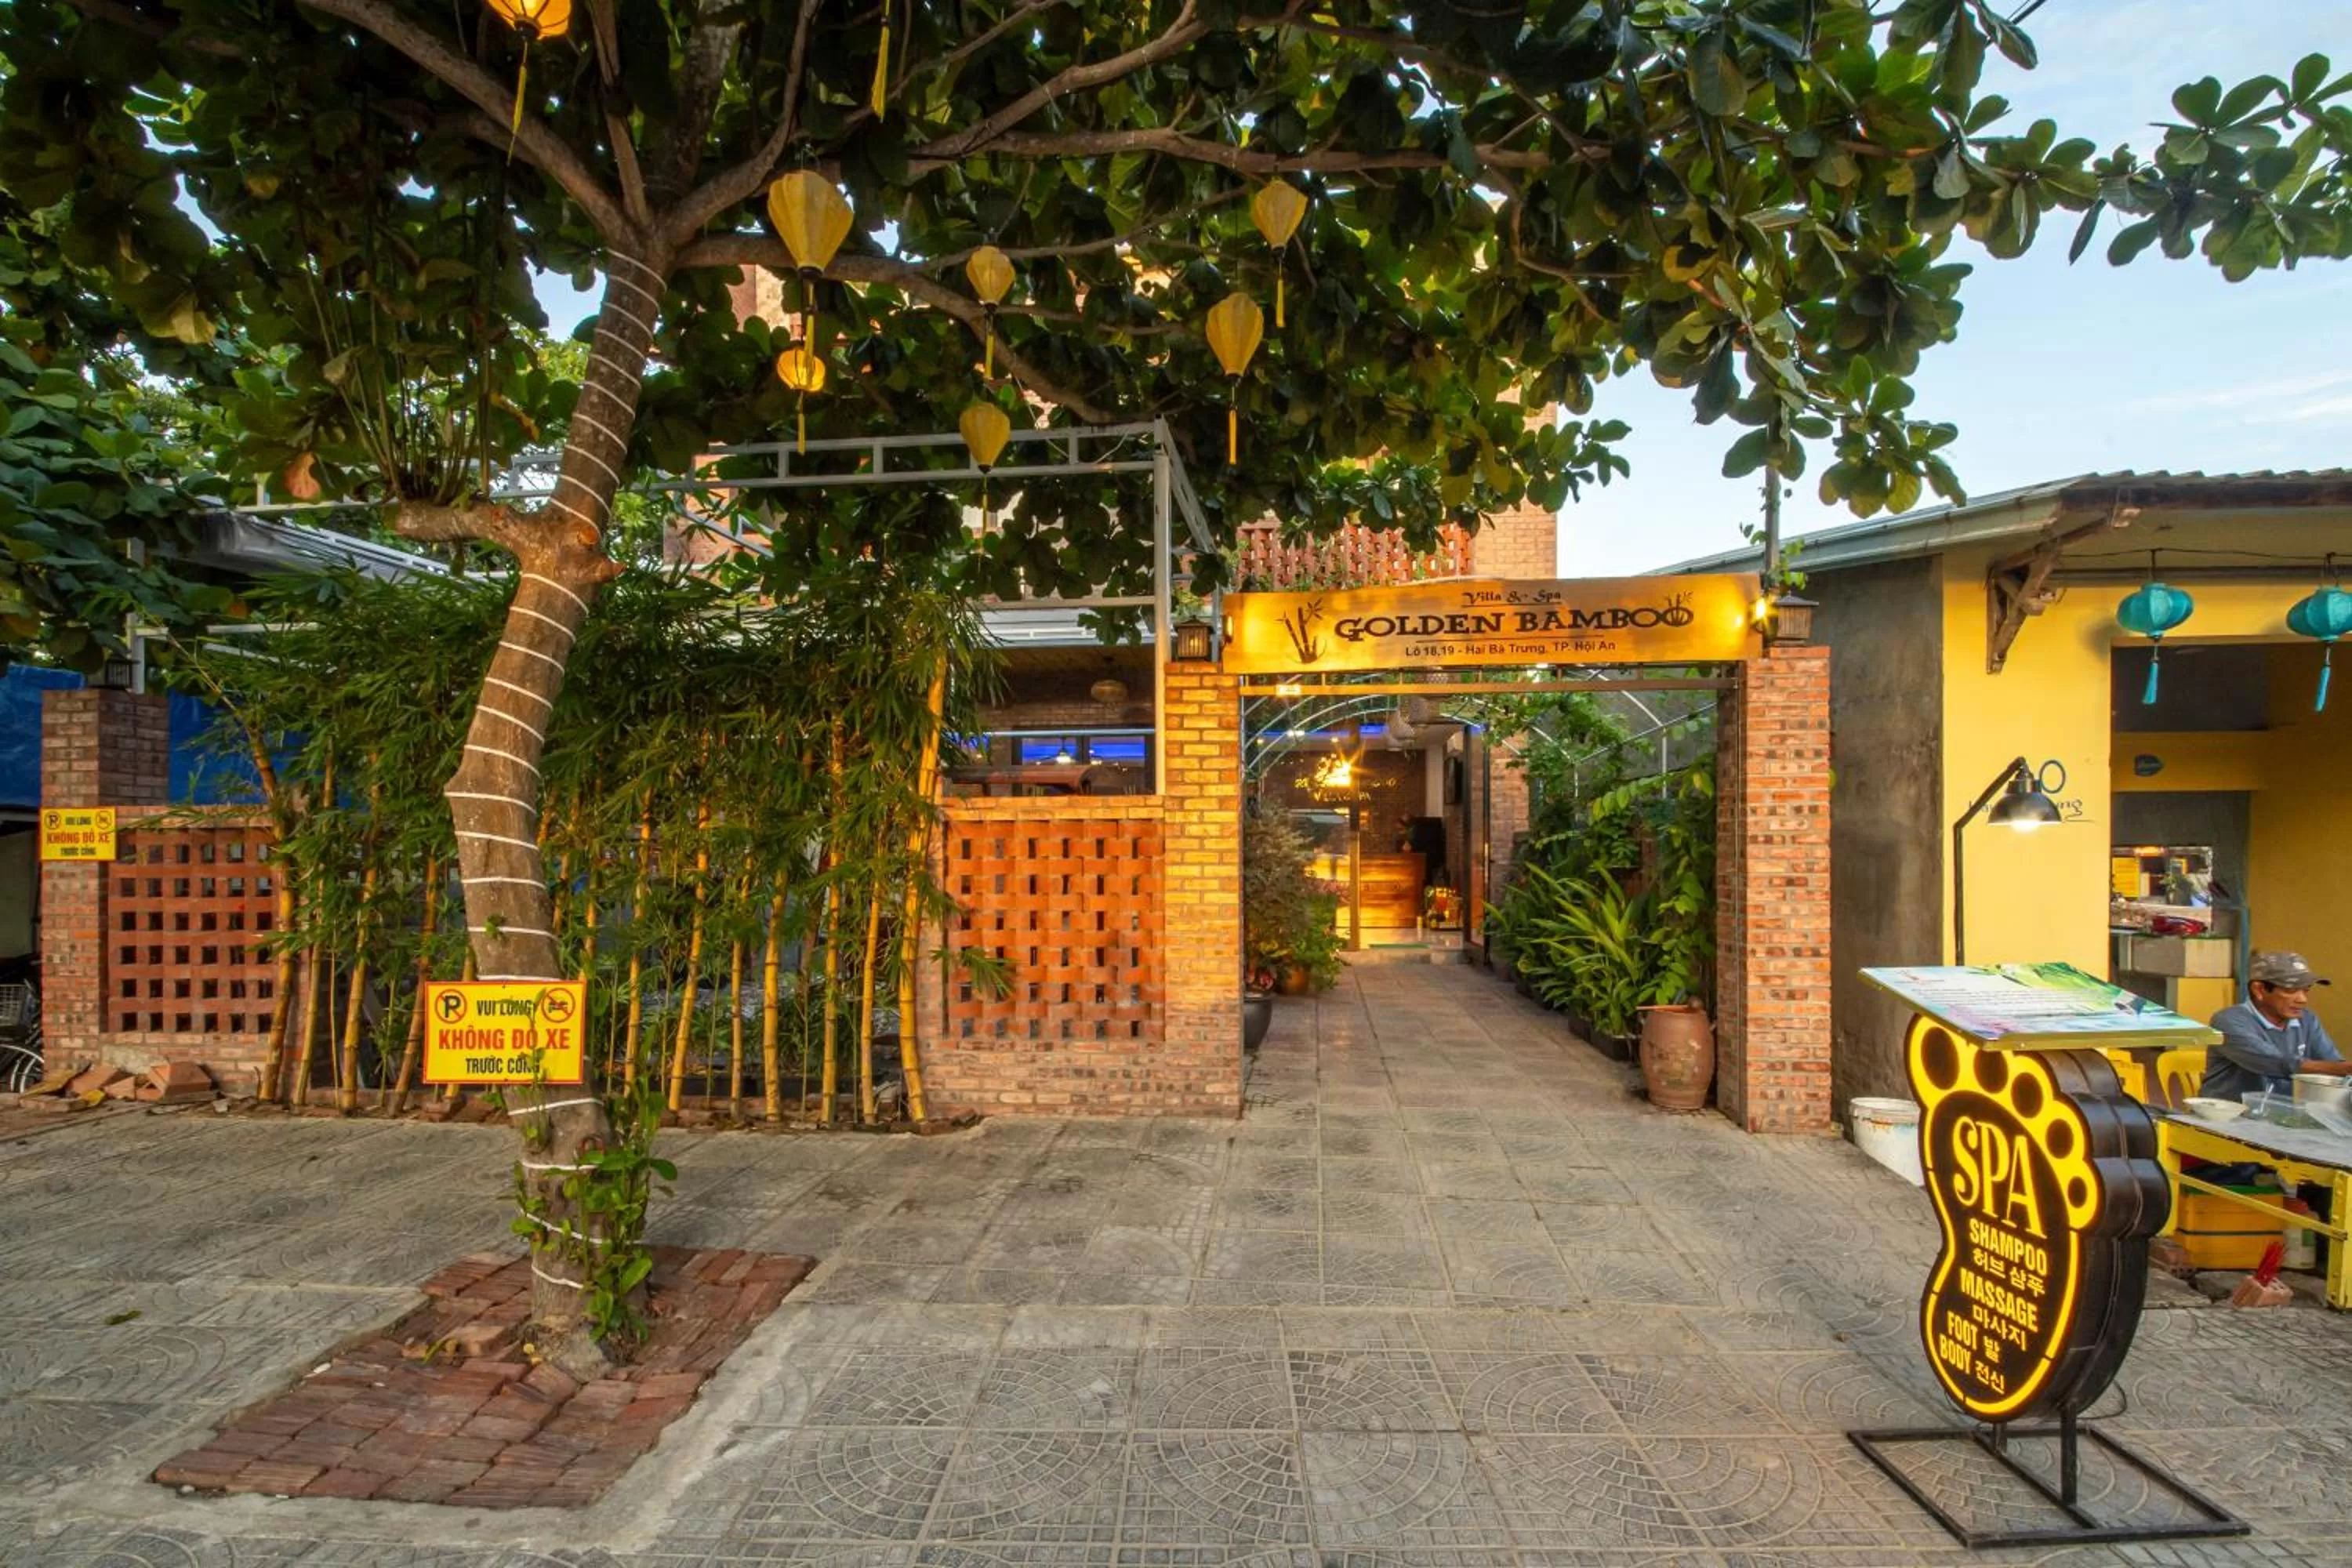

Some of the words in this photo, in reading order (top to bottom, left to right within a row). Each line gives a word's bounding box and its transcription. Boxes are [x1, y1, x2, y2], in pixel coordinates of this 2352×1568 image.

[1463, 590, 1501, 604] Villa
[1534, 589, 1561, 603] Spa
[1334, 612, 1505, 641] GOLDEN
[1514, 607, 1694, 632] BAMBOO
[1465, 643, 1486, 655] Hai
[1599, 641, 1616, 651] An
[477, 1000, 496, 1016] VUI
[438, 1025, 505, 1050] KHÔNG
[545, 1028, 571, 1050] XE
[1953, 1116, 2048, 1240] SPA
[1969, 1218, 2048, 1276] SHAMPOO
[1973, 1248, 2006, 1279] 허브
[1960, 1266, 2038, 1333] MASSAGE
[1947, 1310, 1978, 1351] FOOT
[1972, 1304, 2027, 1352] 마사지
[1939, 1333, 1972, 1374] BODY
